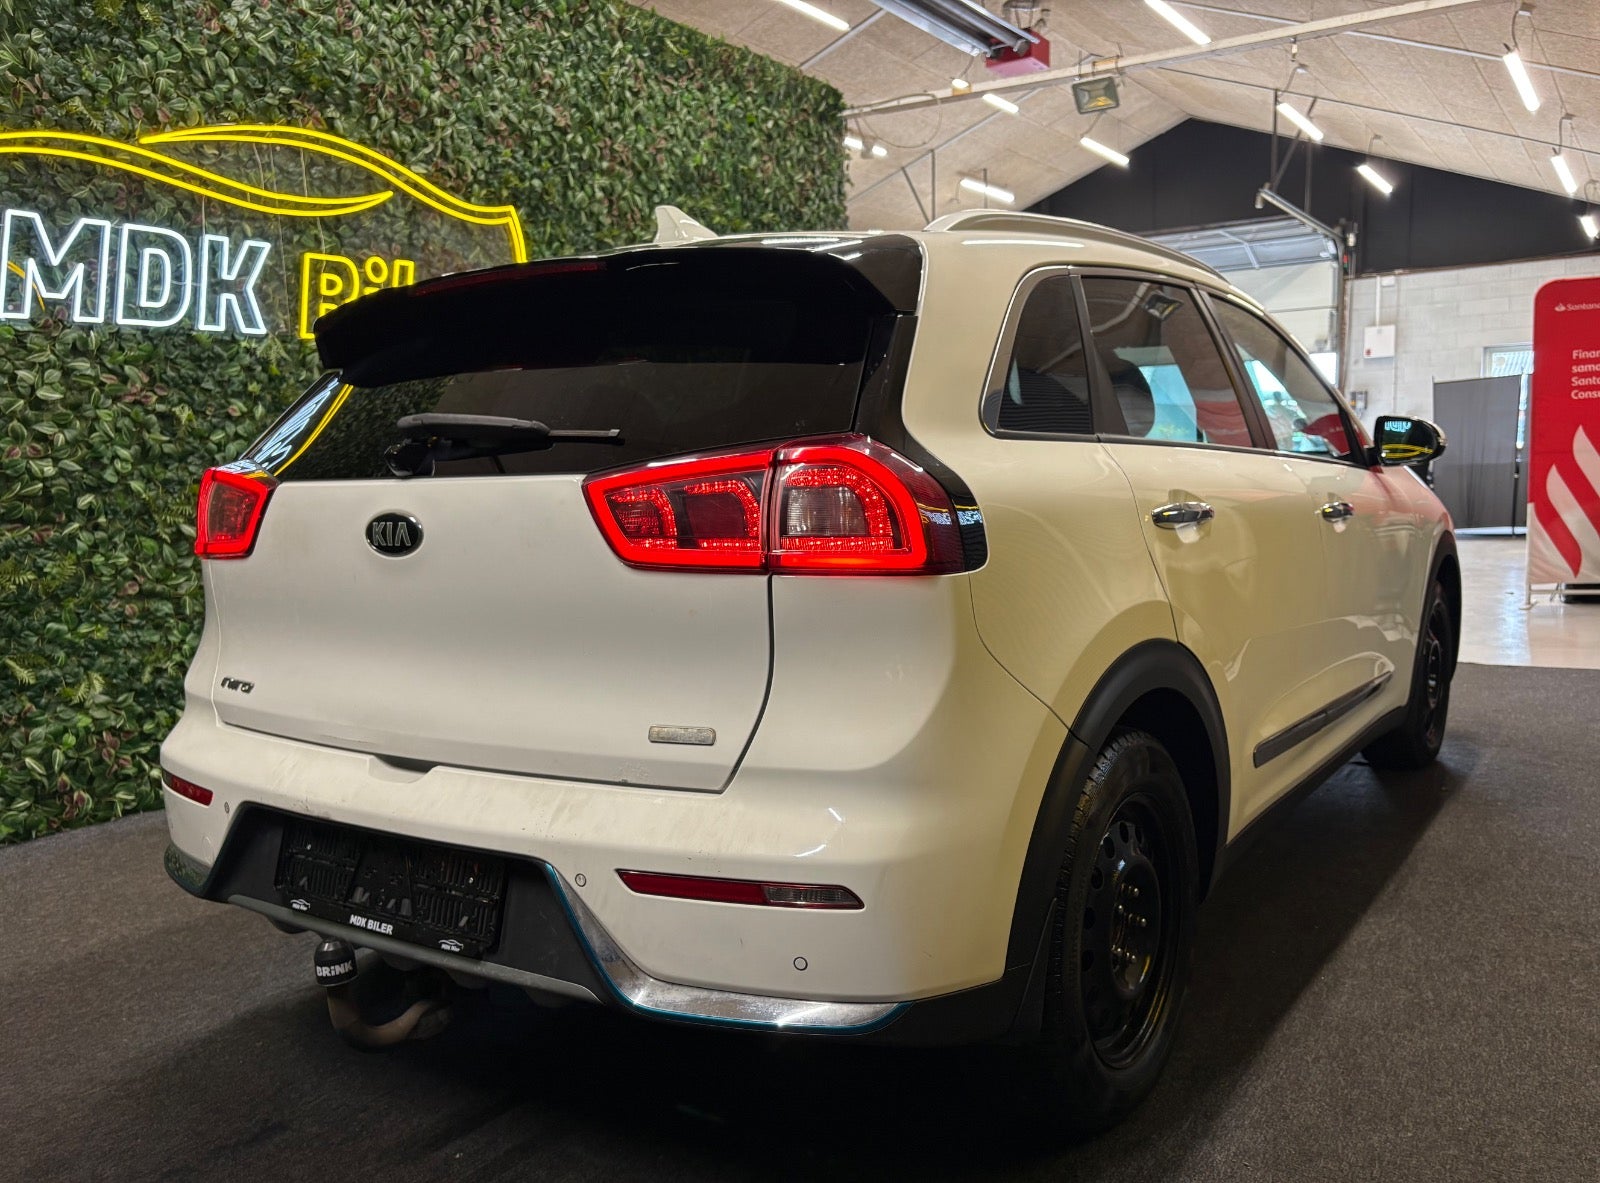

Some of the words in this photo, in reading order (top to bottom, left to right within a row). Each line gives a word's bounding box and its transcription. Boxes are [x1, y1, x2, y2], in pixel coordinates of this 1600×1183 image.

[0, 209, 272, 334] MDK
[372, 521, 412, 547] KIA
[349, 914, 367, 928] MDK
[367, 919, 393, 936] BILER
